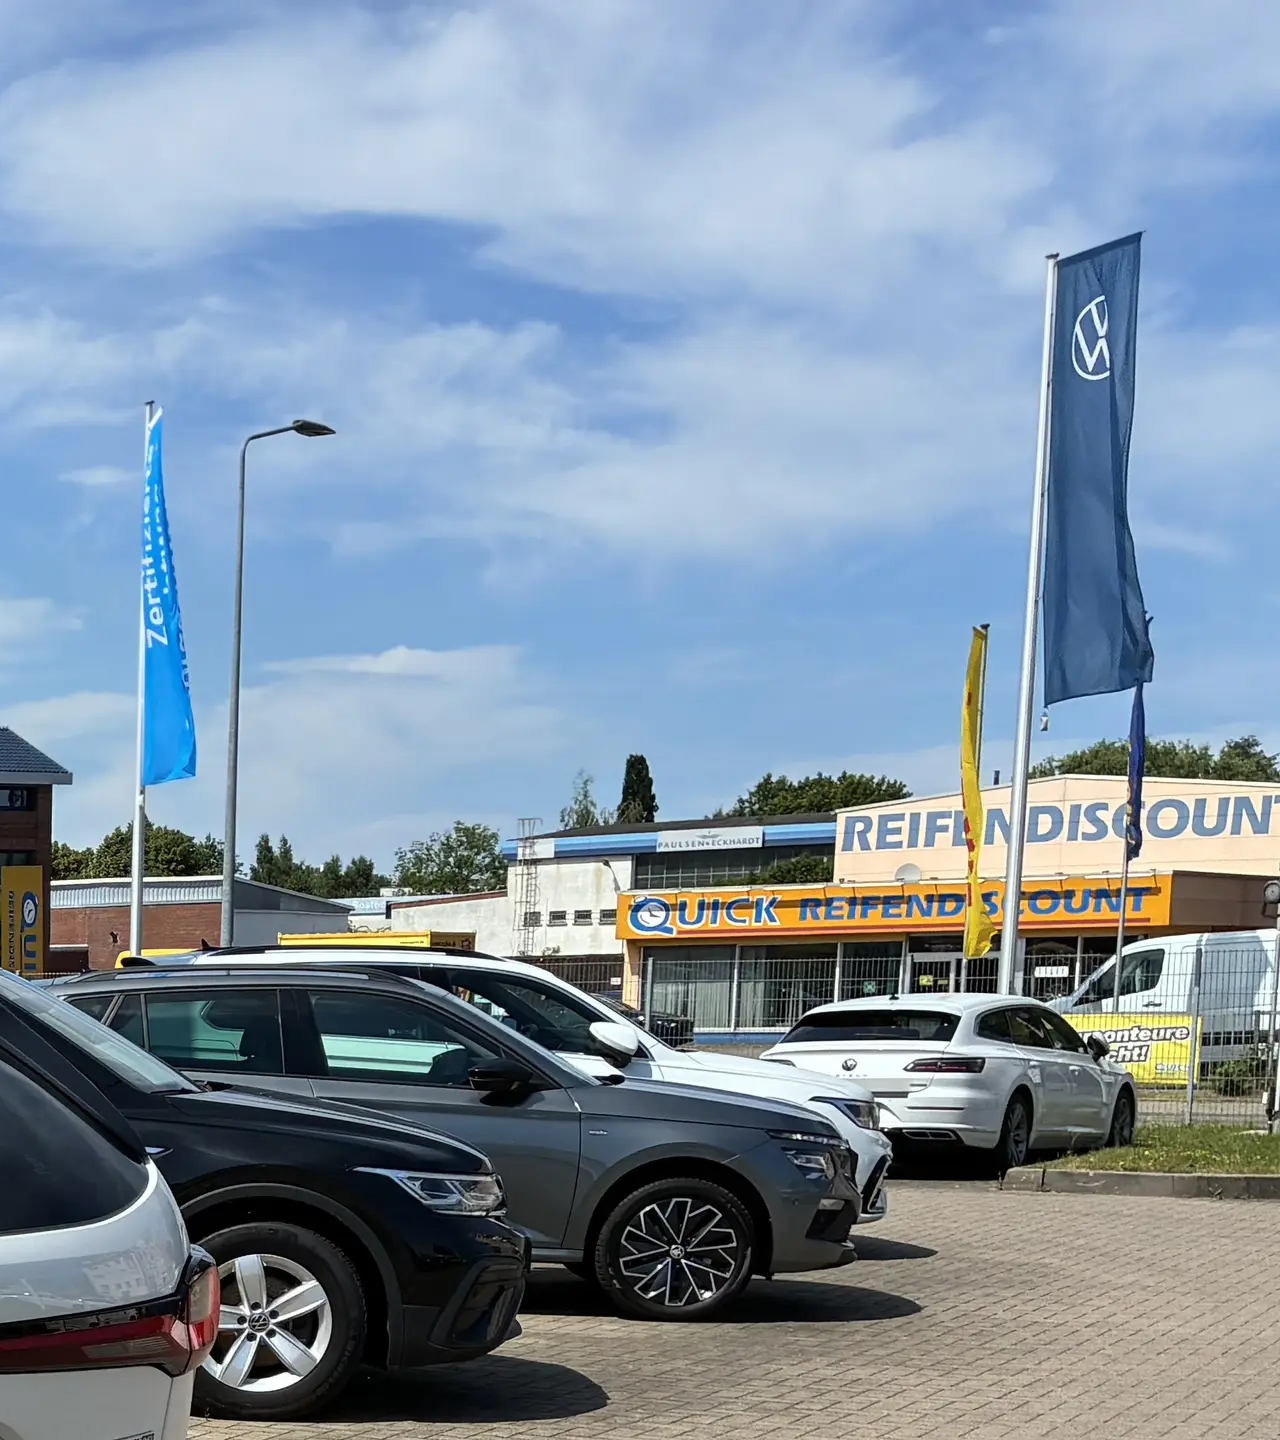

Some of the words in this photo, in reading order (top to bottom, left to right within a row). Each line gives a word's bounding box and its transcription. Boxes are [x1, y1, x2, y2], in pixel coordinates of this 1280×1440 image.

[841, 795, 1280, 852] REIFNDISCOUN
[628, 895, 781, 937] QUICK
[798, 886, 1153, 922] REIFENDSOUNT
